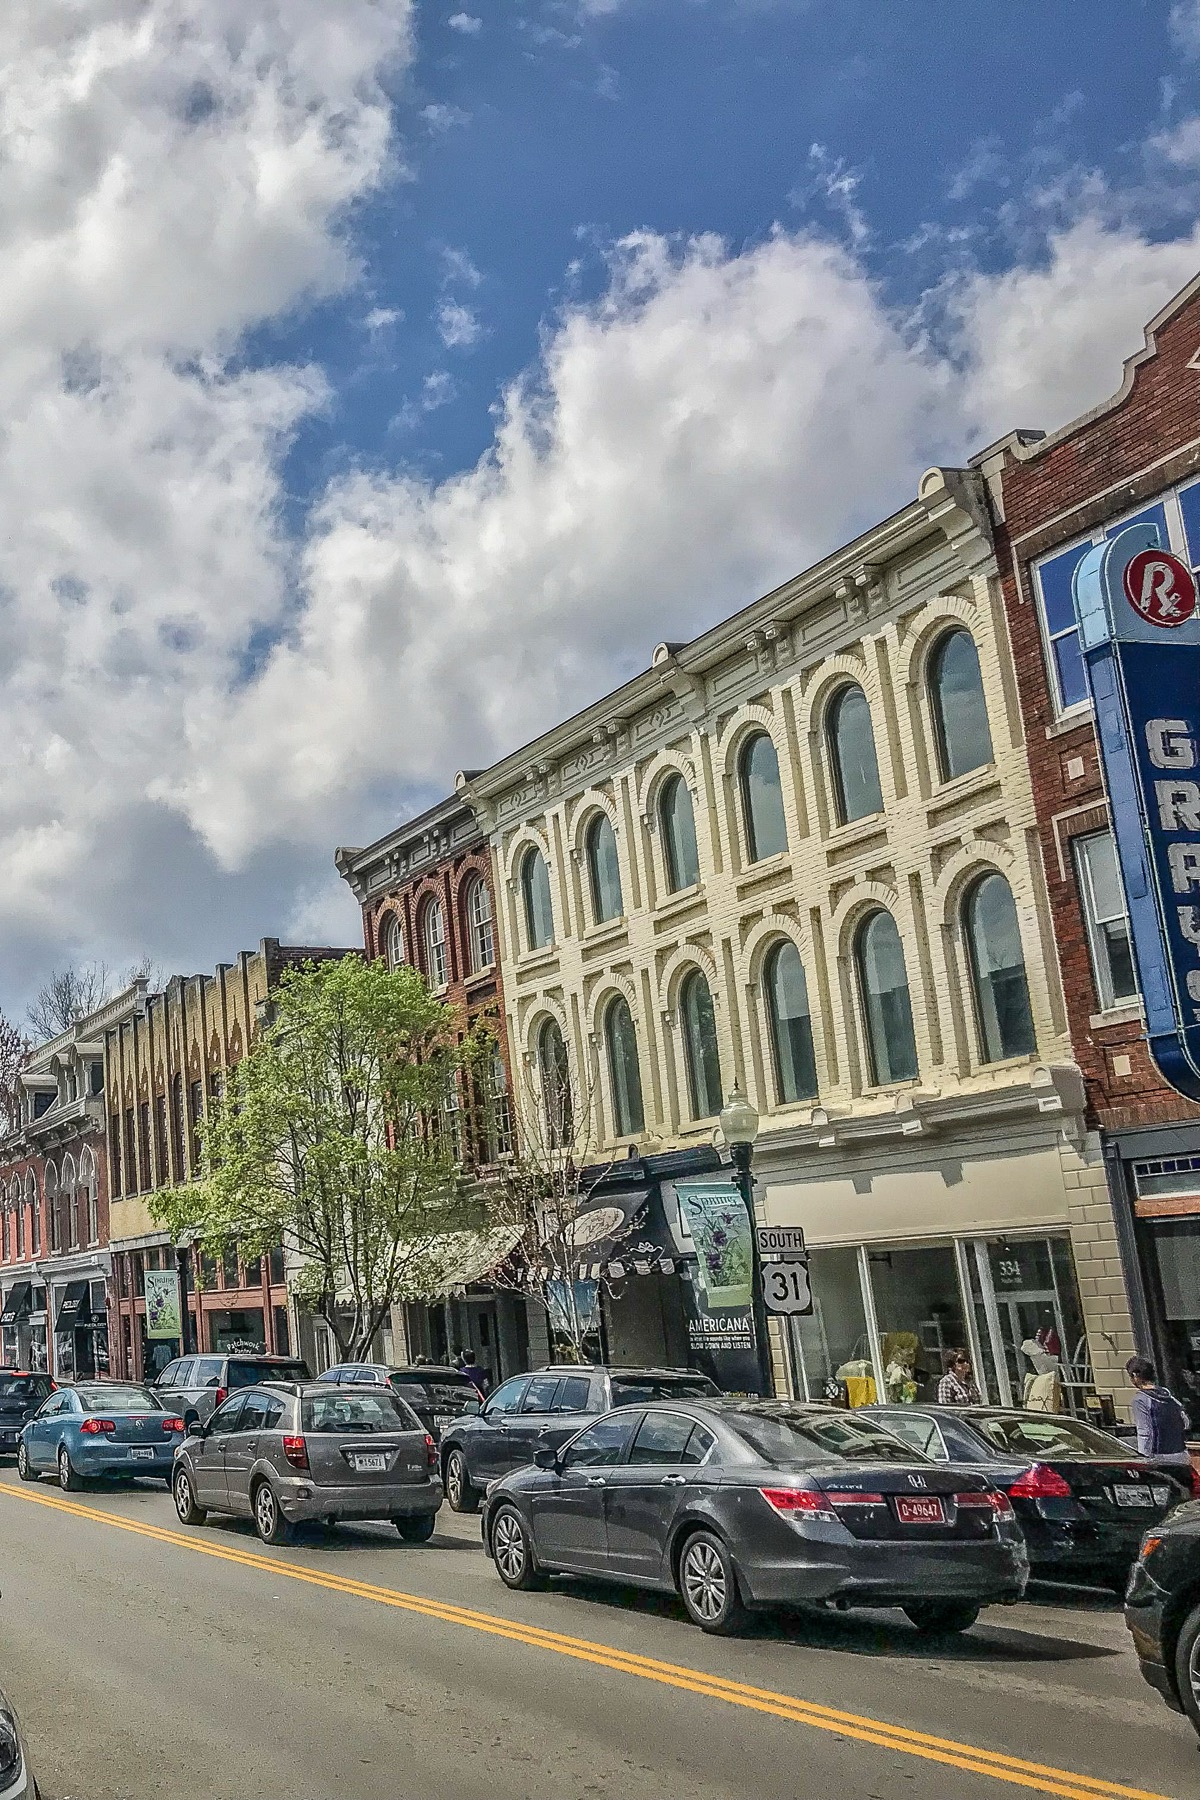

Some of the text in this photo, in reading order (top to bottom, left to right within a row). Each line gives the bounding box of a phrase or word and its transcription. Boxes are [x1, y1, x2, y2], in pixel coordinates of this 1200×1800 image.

[760, 1232, 802, 1248] SOUTH
[999, 1261, 1021, 1276] 334
[771, 1271, 800, 1301] 31
[689, 1317, 750, 1332] AMERICANA
[226, 1338, 260, 1351] Patchwork
[733, 1341, 751, 1349] LISTEN
